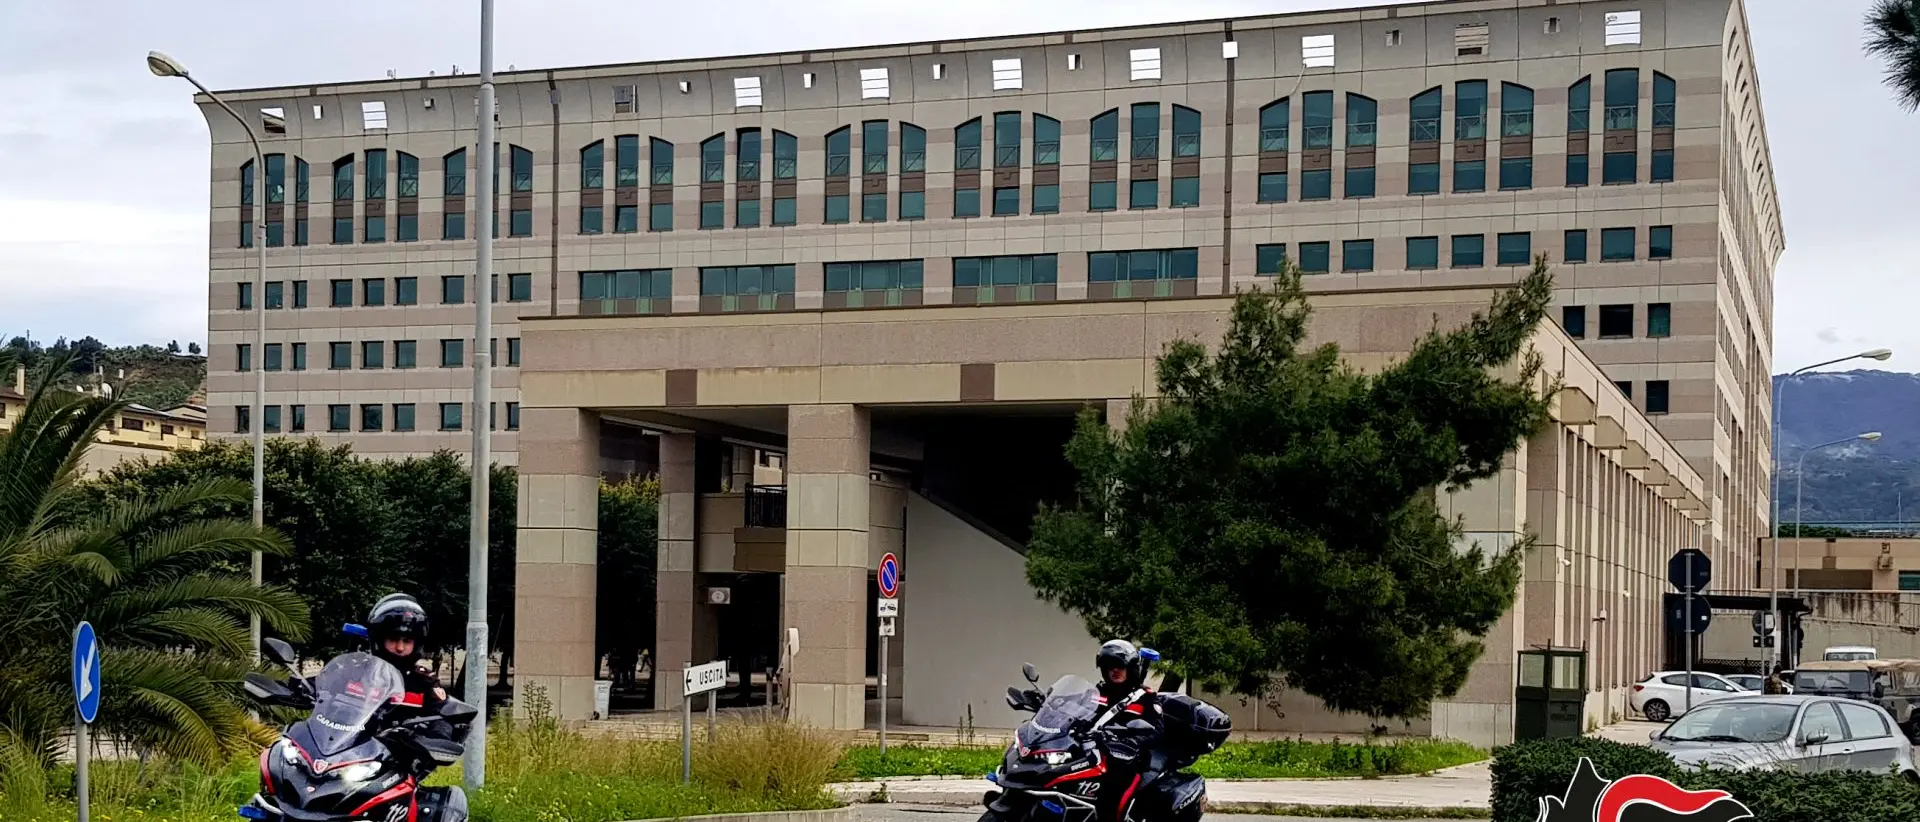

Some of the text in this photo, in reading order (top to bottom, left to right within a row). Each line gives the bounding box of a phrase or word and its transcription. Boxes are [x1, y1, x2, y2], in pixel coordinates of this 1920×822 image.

[700, 667, 724, 685] USCITA
[1076, 780, 1101, 796] 112
[385, 803, 409, 822] 112
